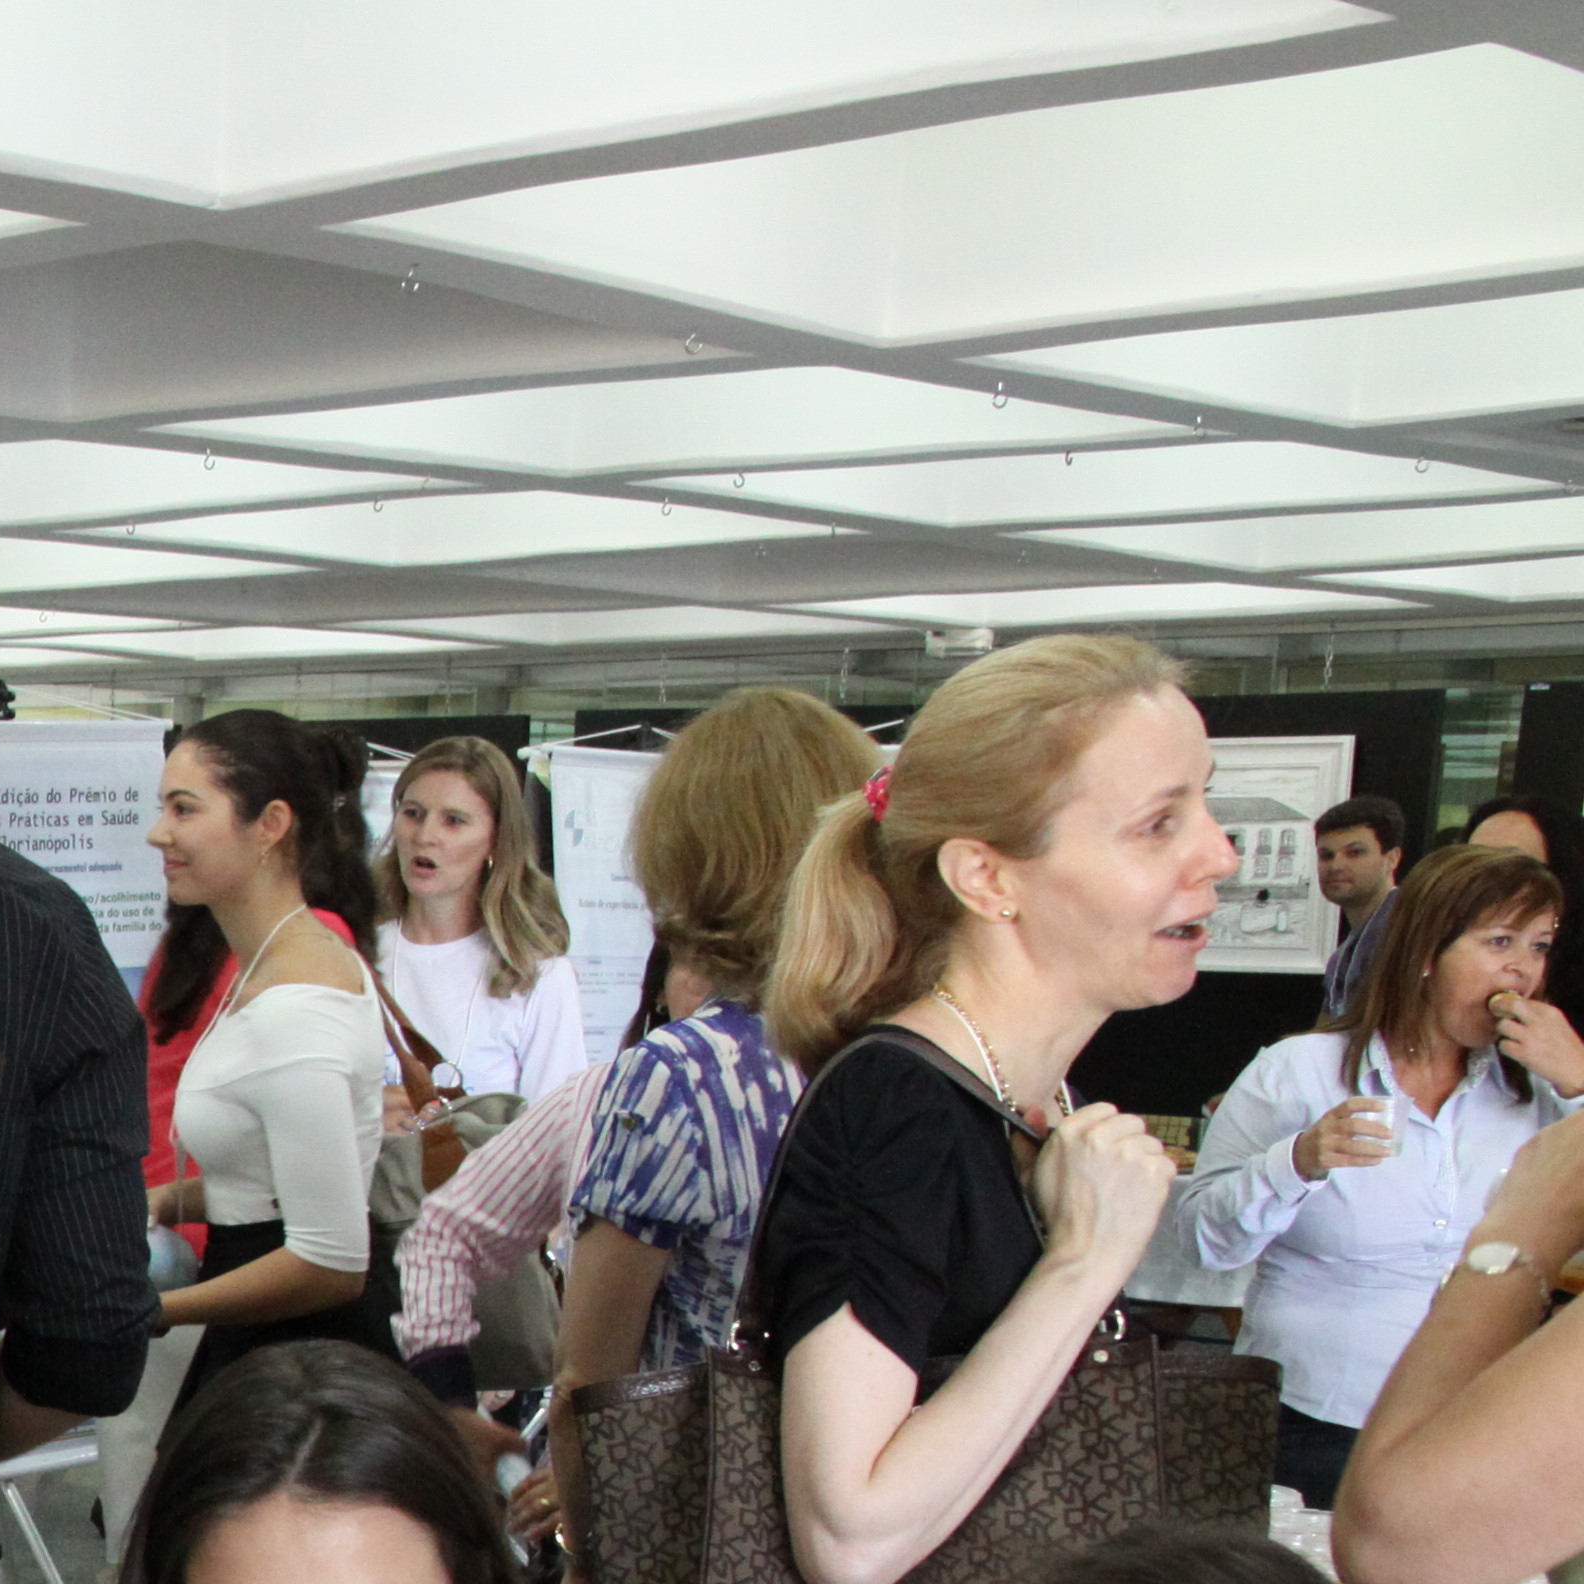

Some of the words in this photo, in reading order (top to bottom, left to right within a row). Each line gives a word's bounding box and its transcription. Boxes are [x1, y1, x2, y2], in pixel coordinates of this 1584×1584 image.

[46, 788, 62, 804] do
[69, 787, 117, 803] Prêmio
[124, 786, 139, 802] de
[9, 810, 69, 828] Práticas
[77, 814, 94, 826] em
[101, 809, 139, 826] Saúde
[107, 906, 120, 918] do
[122, 908, 140, 918] uso
[142, 905, 155, 917] de
[112, 918, 147, 933] família
[149, 919, 163, 931] do
